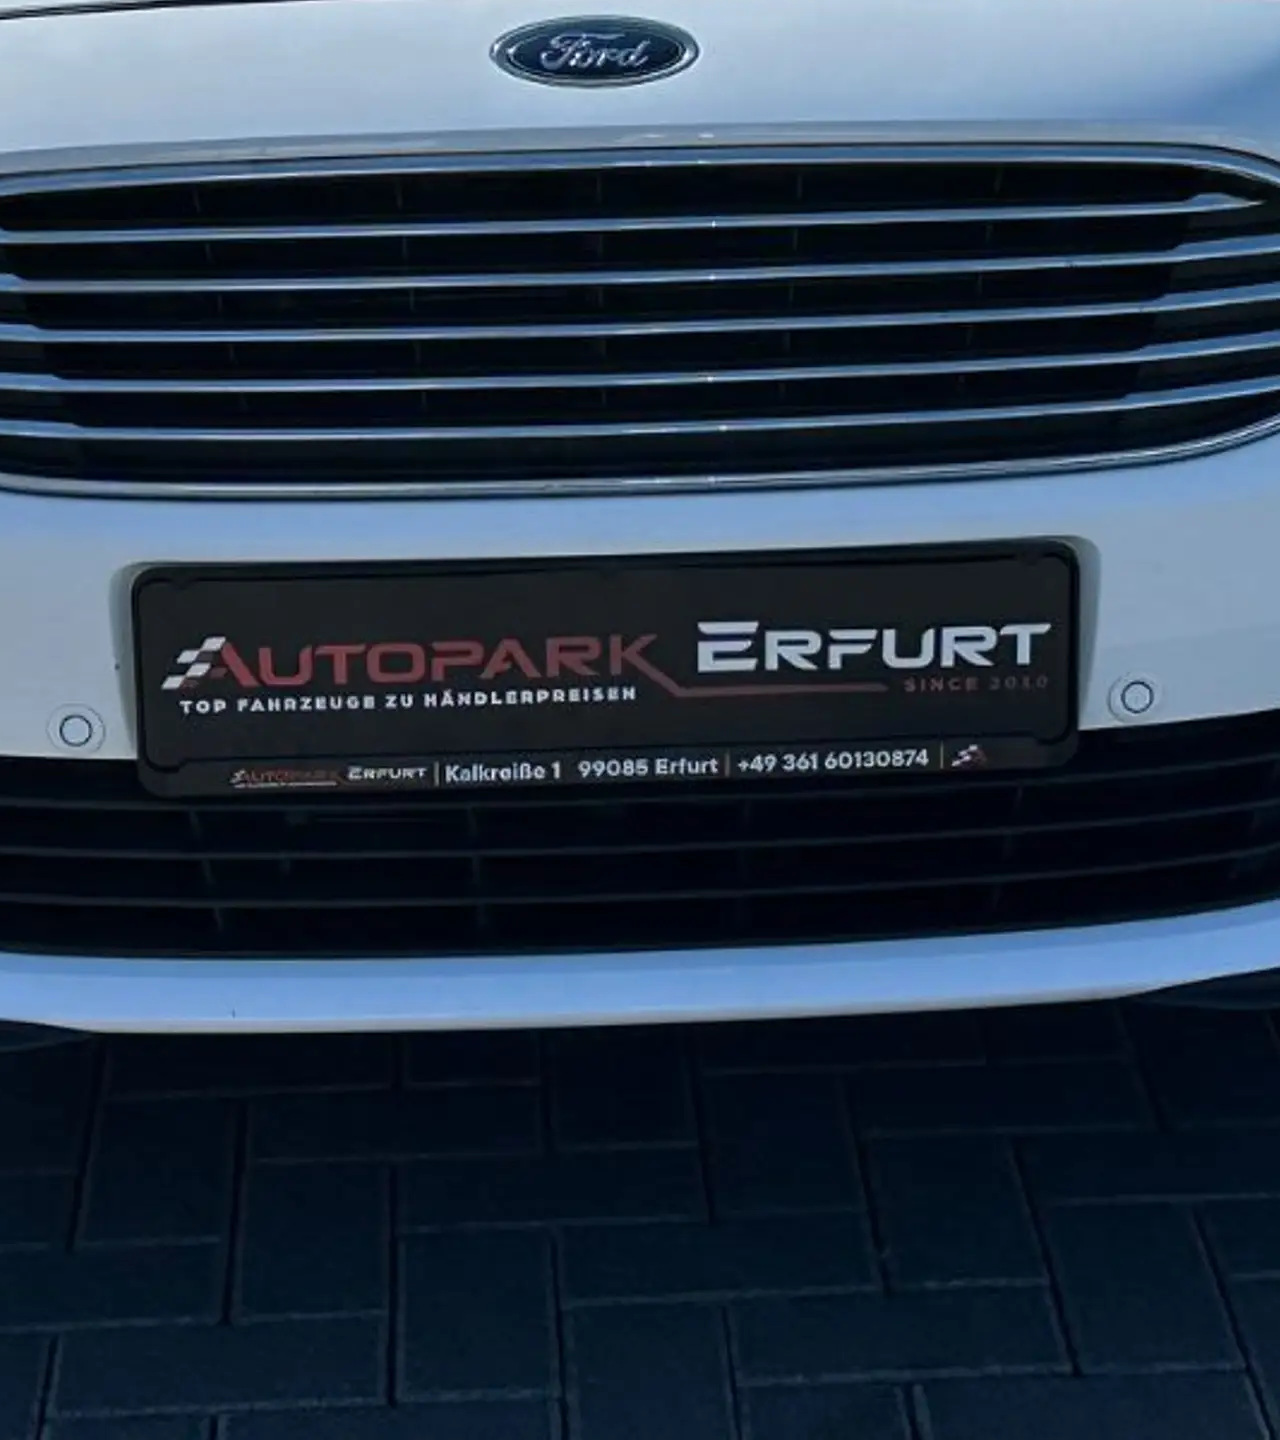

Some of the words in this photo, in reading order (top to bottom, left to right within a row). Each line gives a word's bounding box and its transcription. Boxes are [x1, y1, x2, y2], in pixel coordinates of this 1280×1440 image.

[540, 30, 652, 69] Ford
[197, 634, 658, 687] AUTOPARK
[697, 621, 1052, 673] ERFURT
[180, 699, 227, 714] TOP
[237, 695, 376, 712] FAHRZEUGE
[385, 694, 414, 708] ZU
[423, 686, 637, 707] HÄNDLERPREISEN
[904, 676, 980, 693] SINCE
[551, 761, 561, 779] 1
[578, 758, 648, 777] 99085
[654, 756, 718, 775] Erfurt
[737, 755, 777, 773] +49
[783, 753, 818, 770] 361
[825, 748, 929, 769] 60130874
